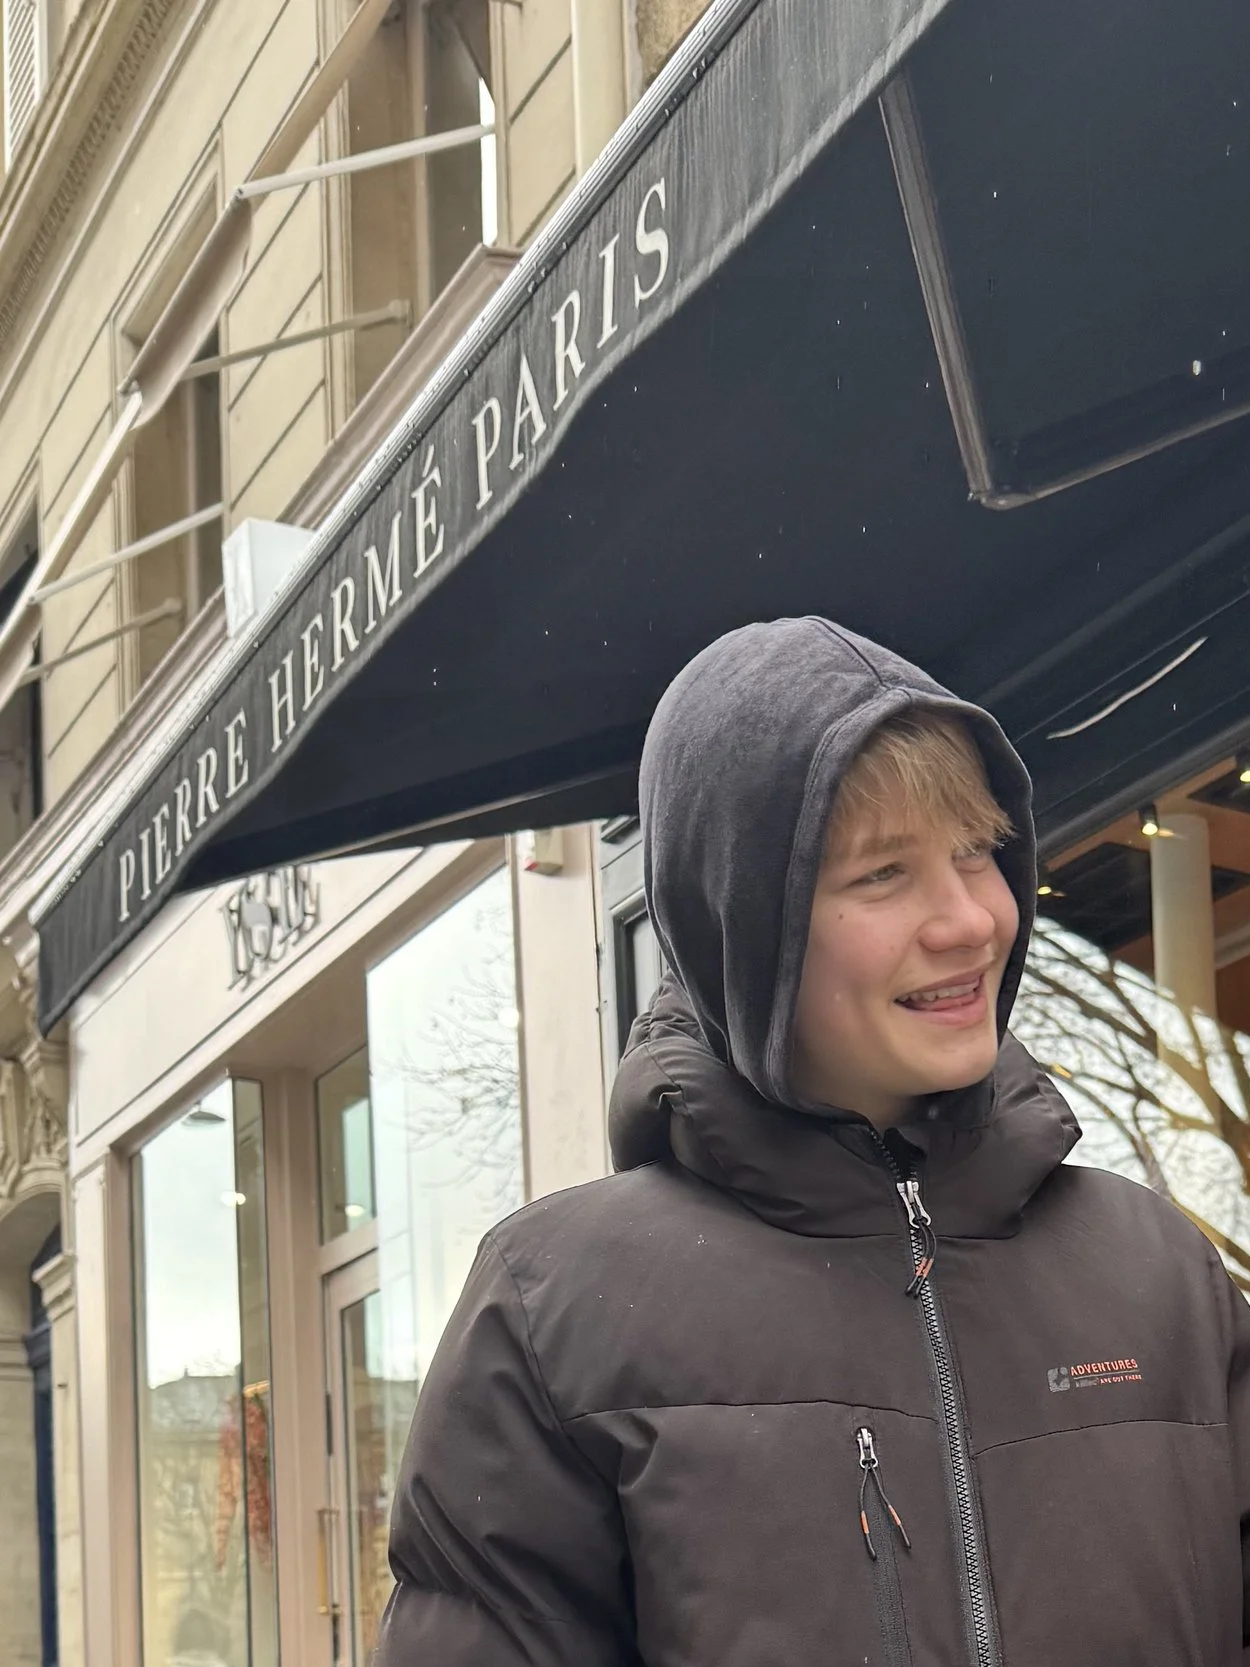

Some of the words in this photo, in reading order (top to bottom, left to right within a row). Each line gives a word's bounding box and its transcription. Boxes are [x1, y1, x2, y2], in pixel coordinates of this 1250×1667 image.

[116, 708, 251, 922] PIERRE
[268, 446, 448, 755] HERMÉ
[473, 176, 672, 511] PARIS
[1070, 1358, 1138, 1376] ADVENTURES
